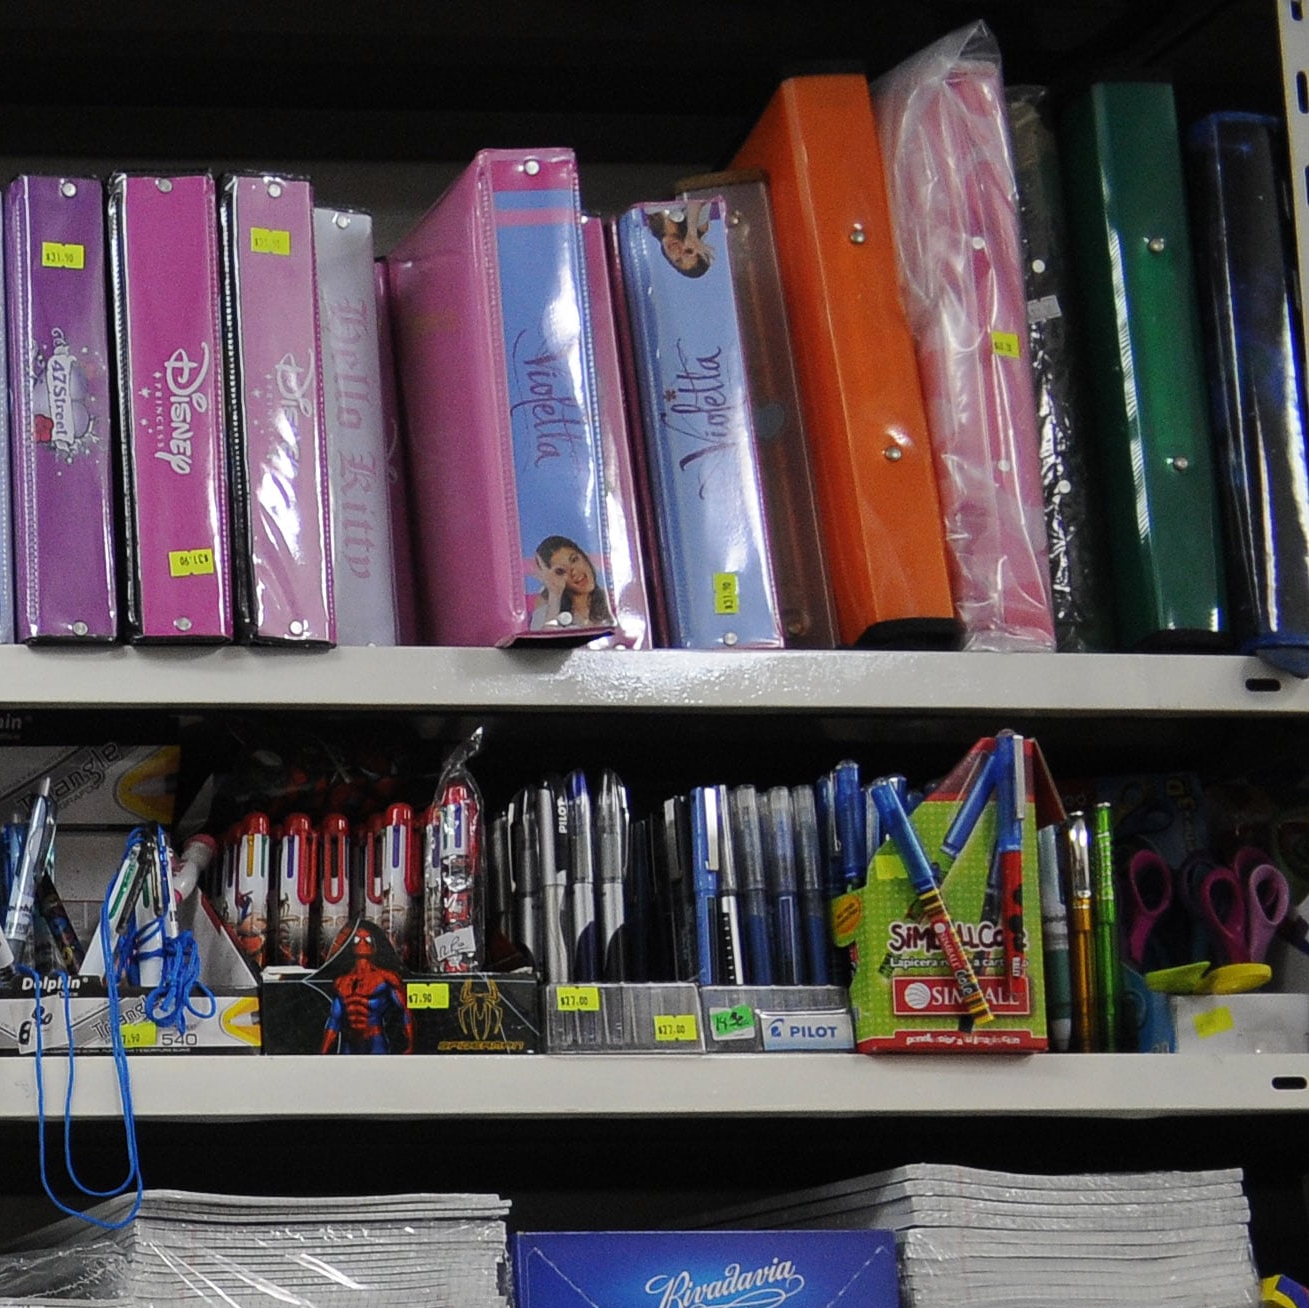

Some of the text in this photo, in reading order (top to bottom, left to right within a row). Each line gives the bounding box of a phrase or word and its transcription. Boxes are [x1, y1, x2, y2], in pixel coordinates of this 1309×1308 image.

[50, 359, 70, 436] 47Street
[153, 383, 164, 448] PRINCESS
[559, 800, 567, 834] PILOT
[409, 994, 432, 1003] $7.90
[162, 1034, 198, 1046] 540
[789, 1025, 837, 1038] PILOT
